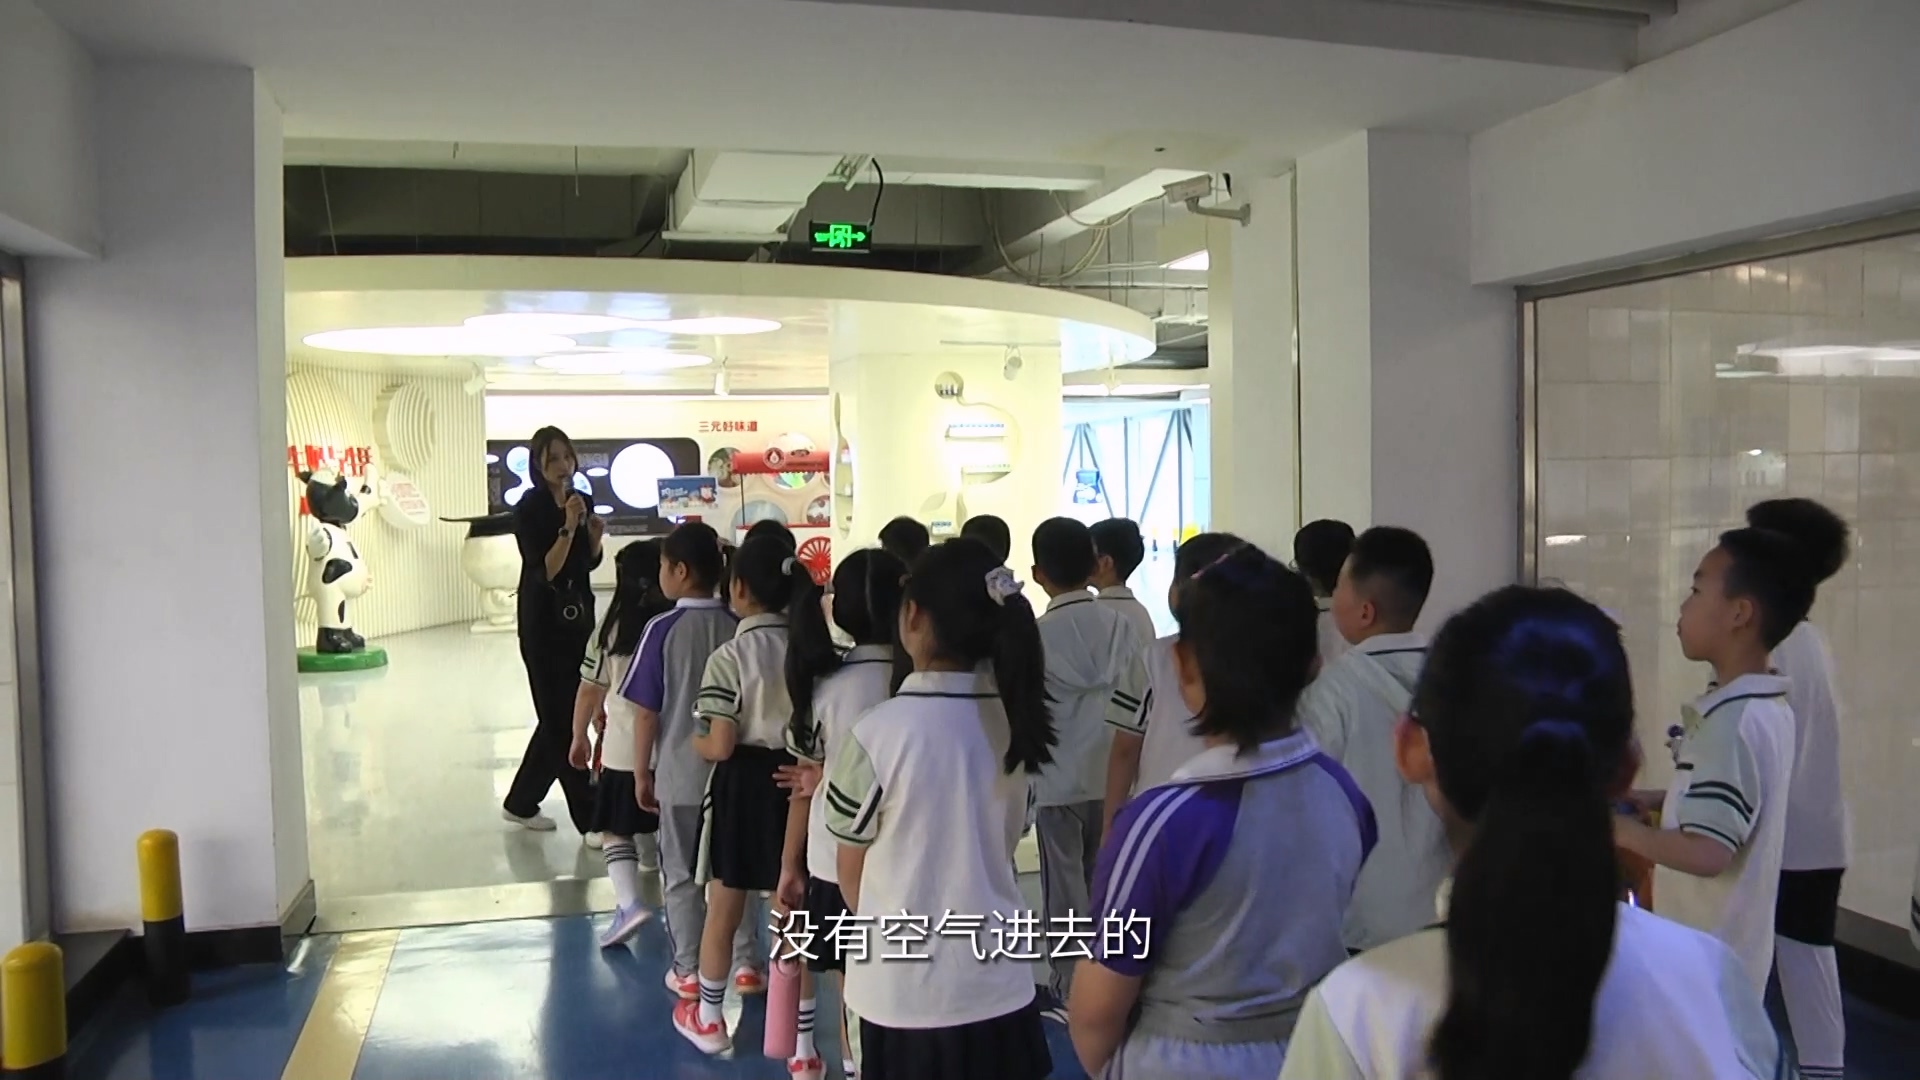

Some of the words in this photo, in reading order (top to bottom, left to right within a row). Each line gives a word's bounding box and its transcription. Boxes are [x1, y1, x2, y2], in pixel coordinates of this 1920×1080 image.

[698, 420, 758, 432] 三元好味道
